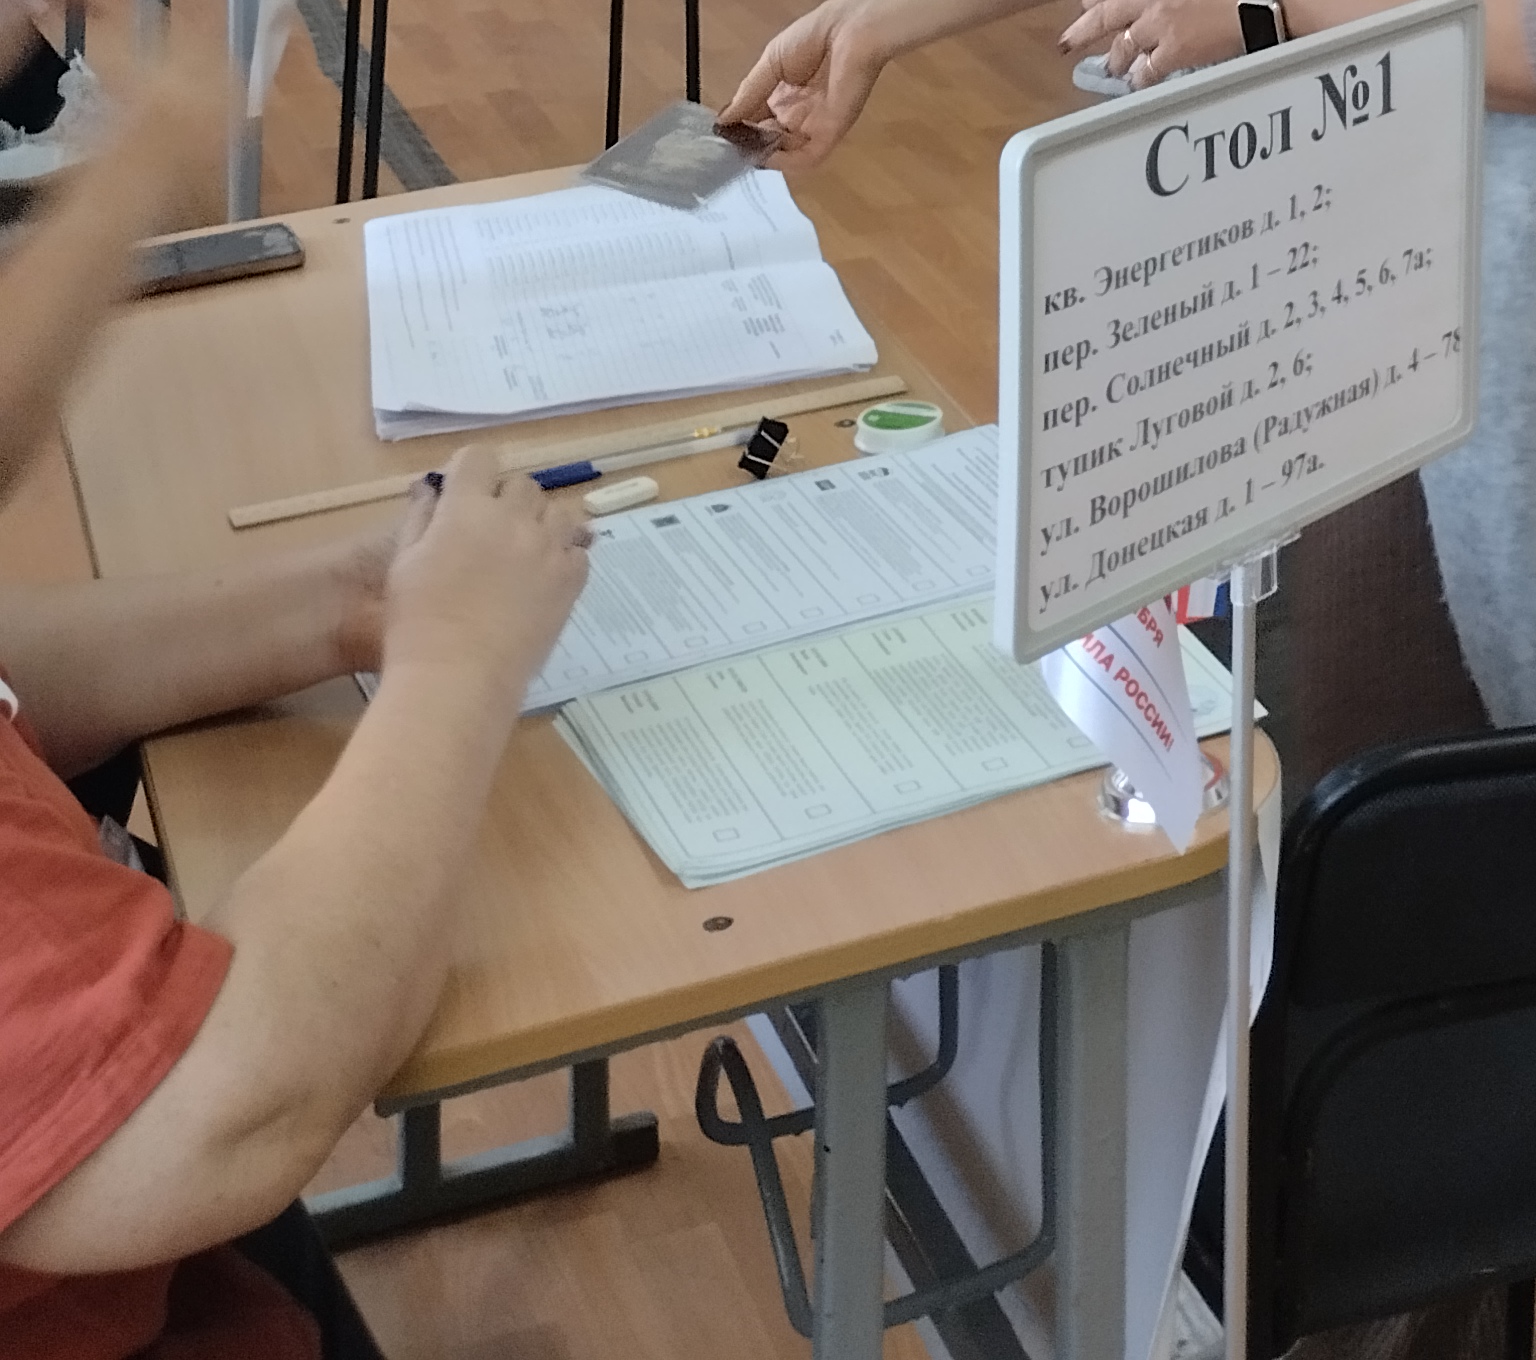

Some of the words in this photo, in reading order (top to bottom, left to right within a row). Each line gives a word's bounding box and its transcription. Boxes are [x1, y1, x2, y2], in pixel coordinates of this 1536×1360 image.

[1145, 105, 1293, 197] Стол
[1310, 50, 1397, 142] №1
[1043, 286, 1086, 315] кв.
[1094, 217, 1255, 297] Энергетиков
[1260, 210, 1281, 236] д.
[1288, 194, 1306, 221] 1,
[1312, 184, 1332, 212] 2;
[1043, 338, 1099, 374] пер.
[1107, 280, 1215, 349] Зеленый
[1220, 280, 1242, 306] д.
[1250, 262, 1260, 291] 1
[1286, 241, 1319, 275] 22;
[1041, 396, 1098, 431] пер.
[1105, 320, 1252, 404] Солнечный
[1256, 319, 1277, 344] д.
[1282, 301, 1302, 330] 2,
[1307, 289, 1327, 319] 3,
[1331, 279, 1350, 305] 4,
[1355, 268, 1374, 296] 5,
[1378, 257, 1397, 285] 6,
[1402, 247, 1434, 276] 7а;
[1040, 437, 1123, 492] тупик
[1129, 380, 1234, 451] Луговой
[1239, 378, 1261, 405] д.
[1267, 361, 1286, 390] 2,
[1292, 347, 1314, 377] 6;
[1040, 516, 1080, 556] ул.
[1089, 436, 1247, 527] Ворошилова
[1252, 368, 1379, 454] (Радужная)
[1383, 364, 1403, 390] д.
[1407, 347, 1419, 372] 4
[1039, 573, 1080, 614] ул.
[1084, 506, 1210, 591] Донецкая
[1213, 496, 1236, 523] д.
[1245, 477, 1255, 506] 1
[1280, 451, 1326, 488] 97а.
[1113, 666, 1175, 753] РОССИИ!
